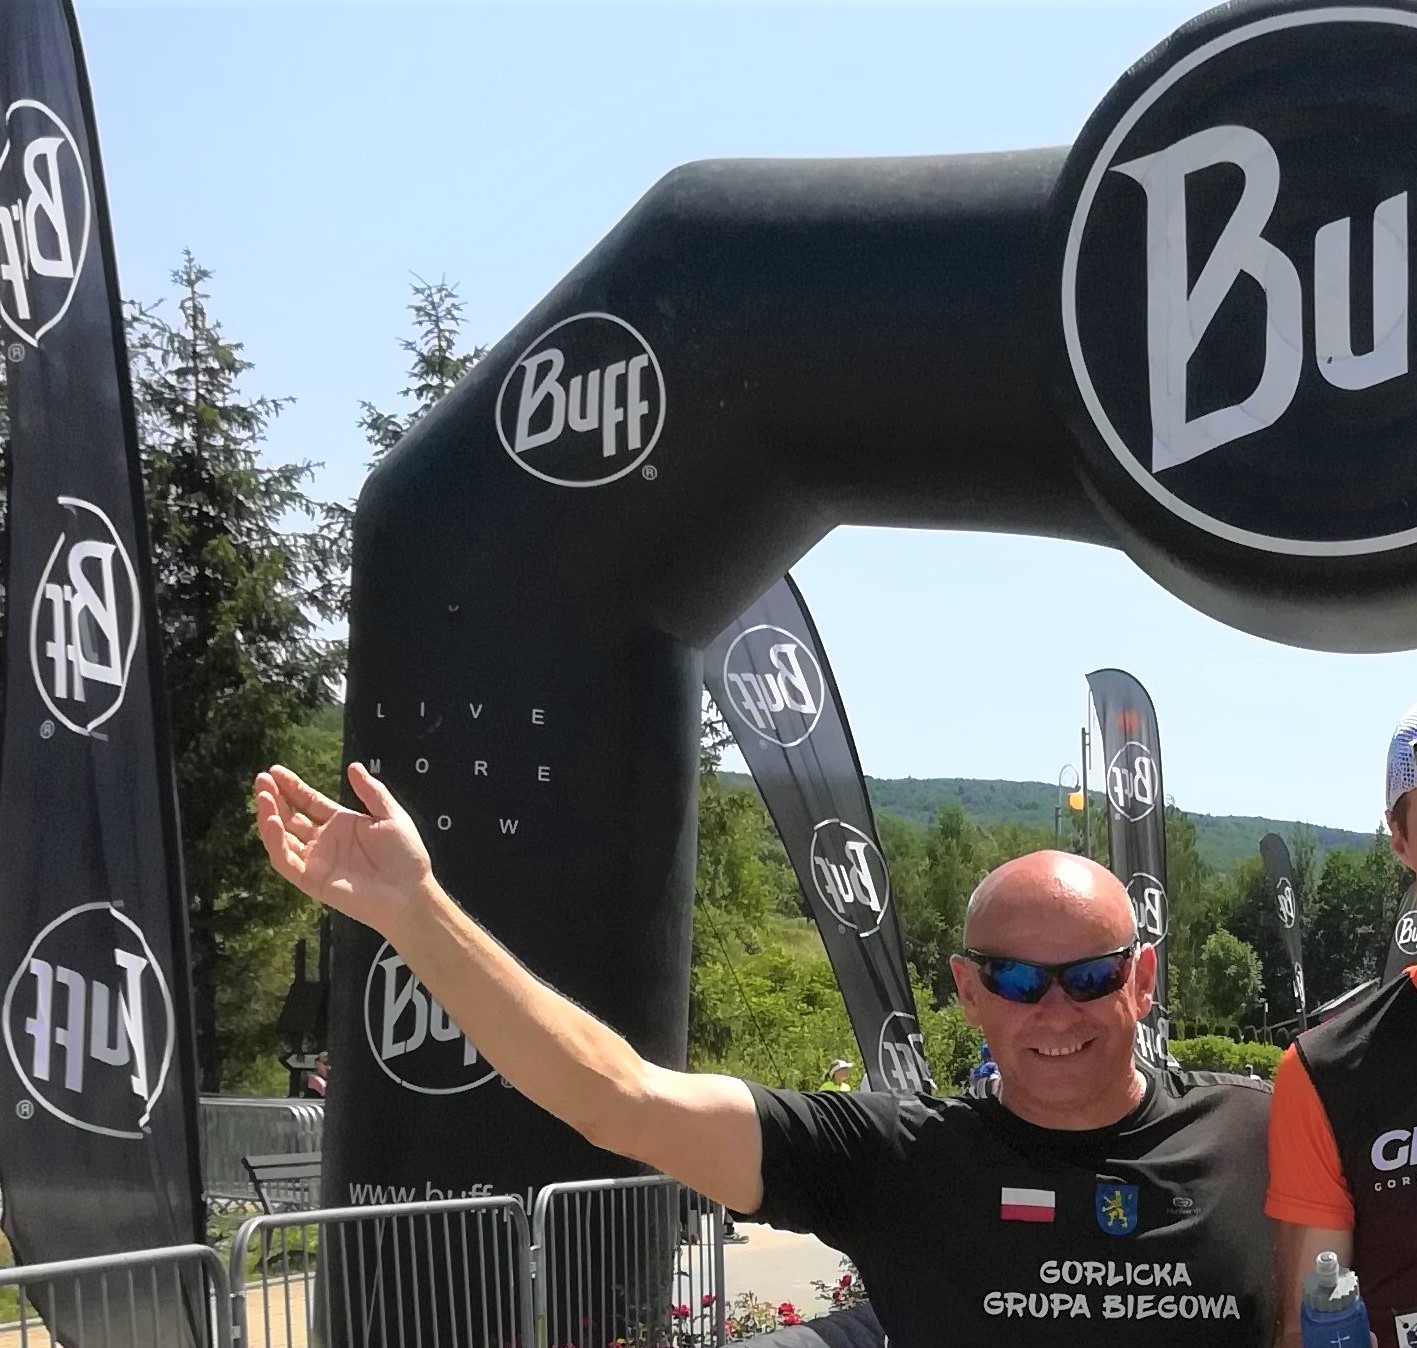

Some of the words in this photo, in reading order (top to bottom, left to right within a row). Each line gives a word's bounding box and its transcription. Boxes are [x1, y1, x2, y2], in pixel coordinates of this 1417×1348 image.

[376, 701, 545, 725] LIVE
[370, 757, 551, 782] MORE
[437, 814, 519, 835] OW
[1039, 1260, 1192, 1287] GORLICKA
[983, 1292, 1091, 1319] GRUPA
[1103, 1294, 1242, 1320] BIEGOWA
